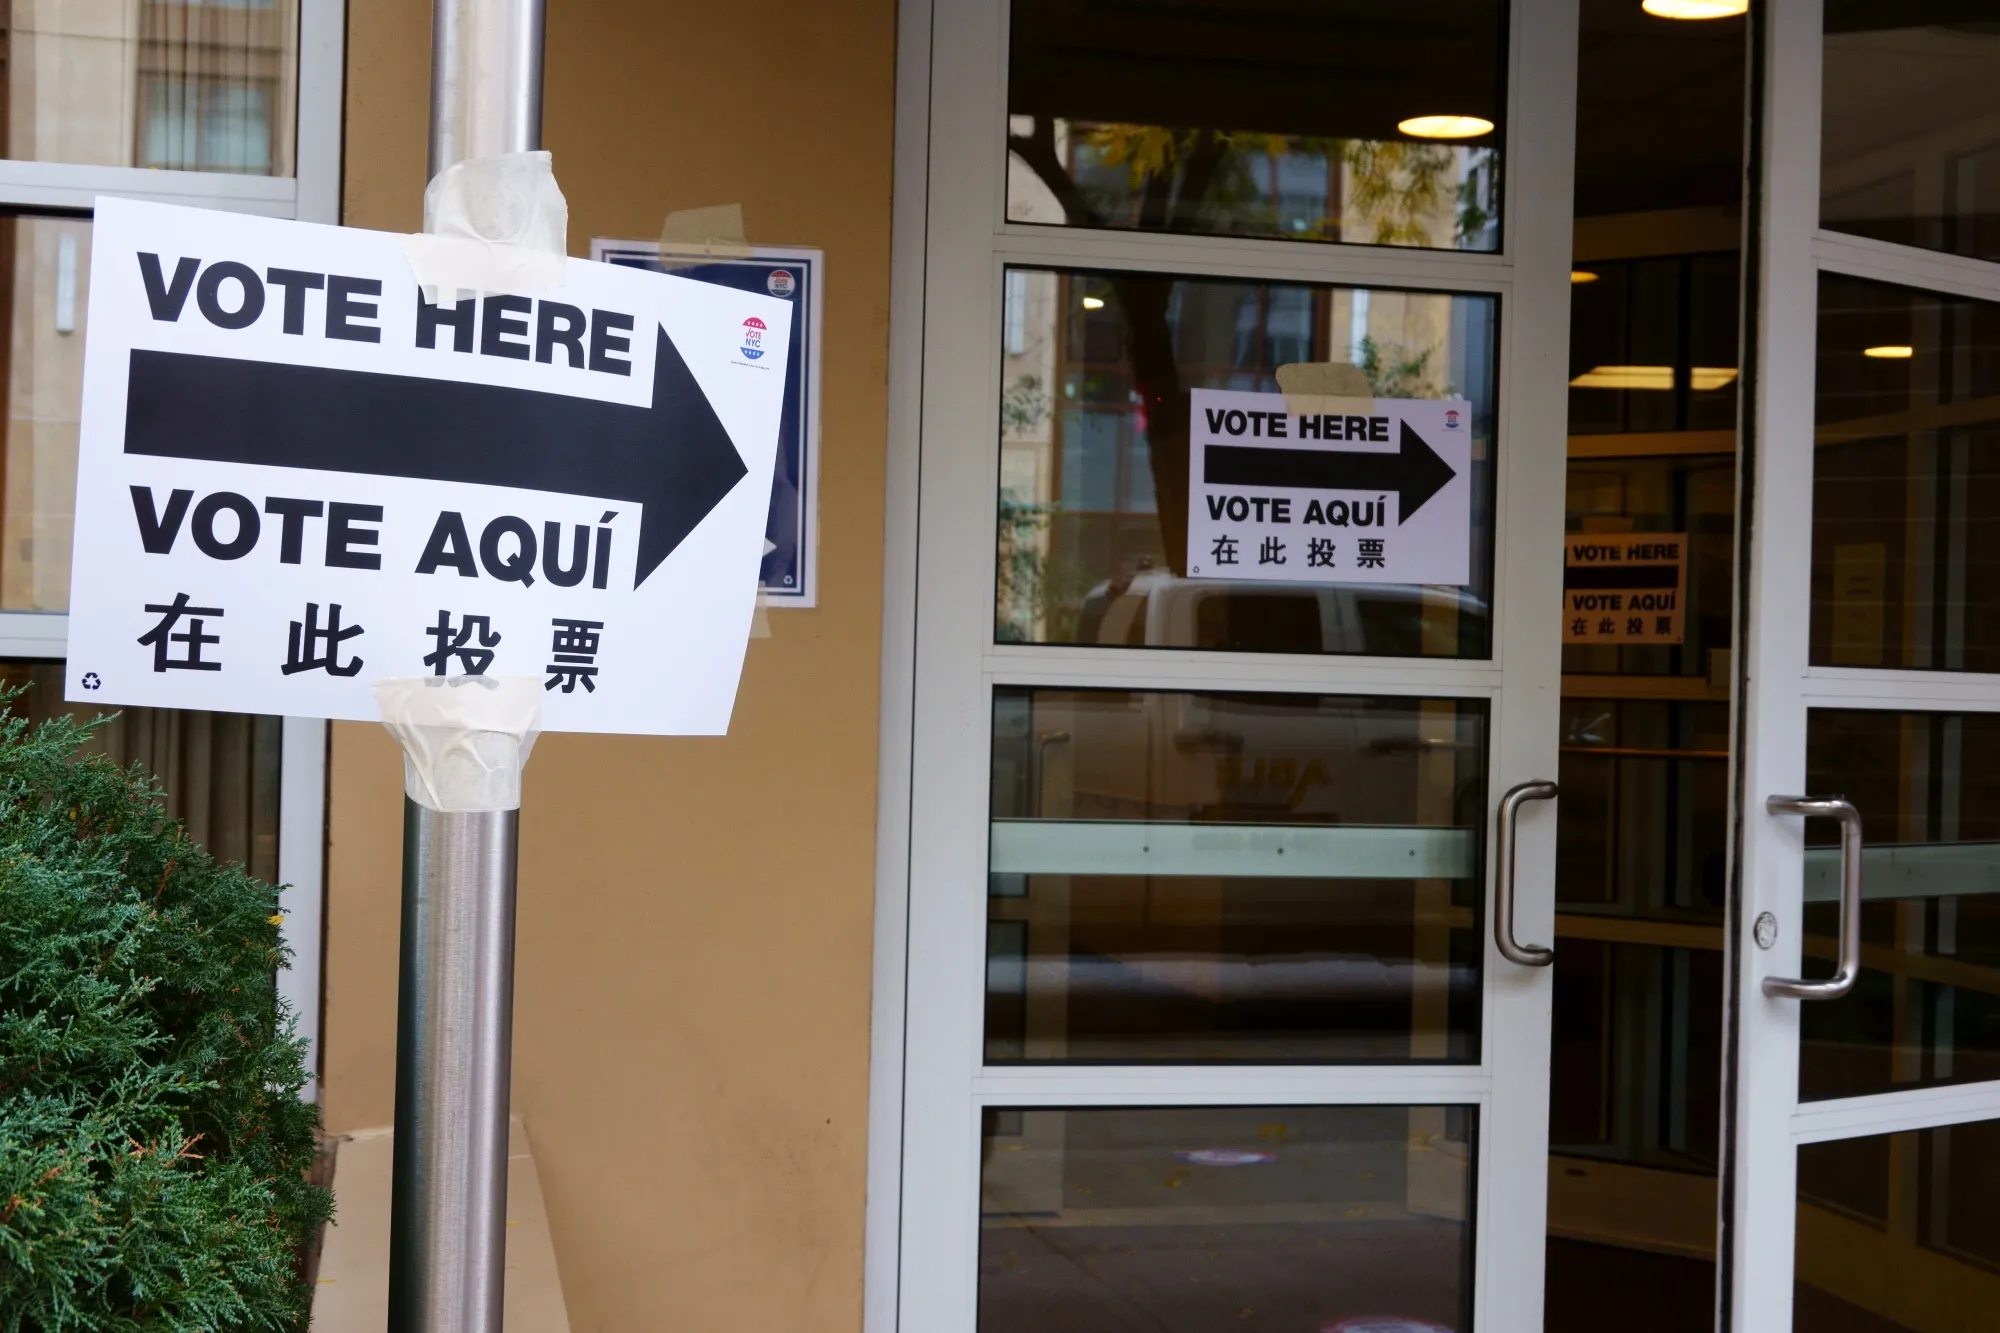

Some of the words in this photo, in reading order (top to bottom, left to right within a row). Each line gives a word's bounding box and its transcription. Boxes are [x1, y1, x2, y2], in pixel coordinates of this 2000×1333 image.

[136, 251, 383, 344] VOTE
[415, 284, 635, 377] HERE
[745, 328, 762, 340] VOTE
[745, 338, 761, 348] NYC
[1205, 408, 1288, 438] VOTE
[1299, 414, 1389, 442] HERE
[1206, 495, 1291, 523] VOTE
[1303, 495, 1387, 528] AQUÍ
[129, 485, 384, 571] VOTE
[414, 510, 620, 590] AQUÍ
[1211, 534, 1385, 569] 在此投票
[1573, 545, 1621, 561] VOTE
[1627, 543, 1679, 560] HERE
[1573, 594, 1622, 610] VOTE
[1628, 589, 1676, 611] AQUÍ
[137, 592, 605, 694] 在此投票
